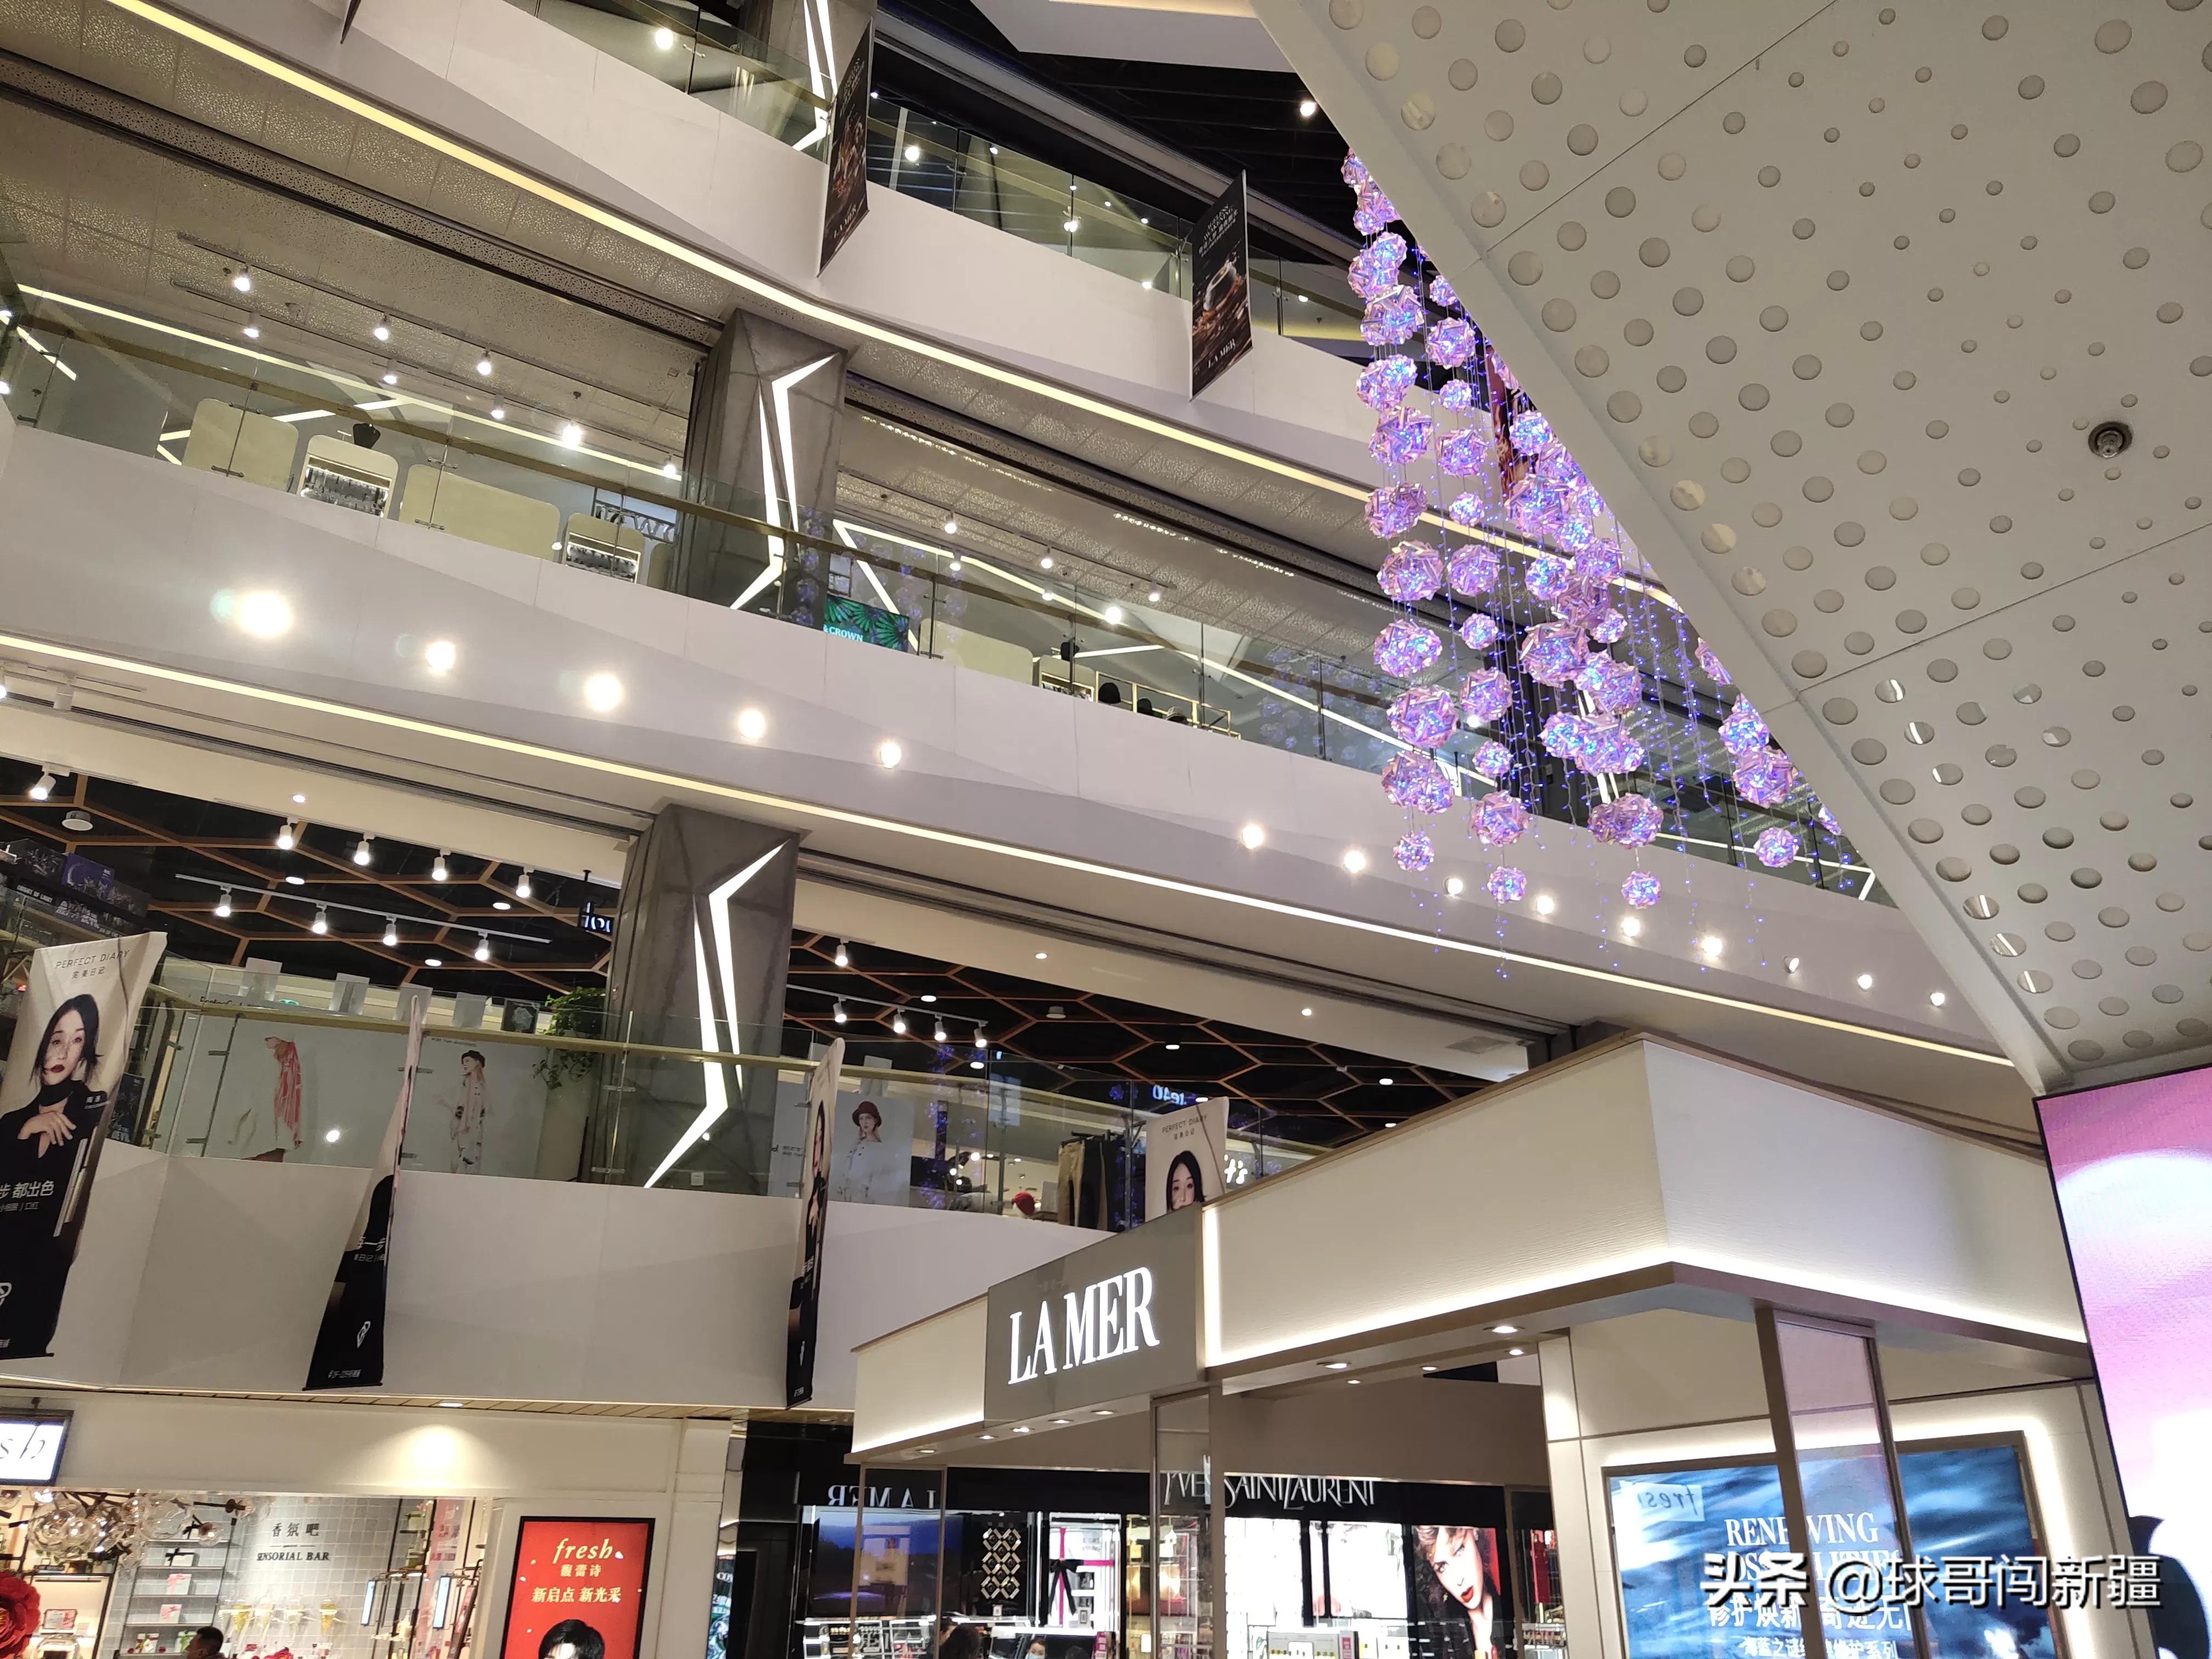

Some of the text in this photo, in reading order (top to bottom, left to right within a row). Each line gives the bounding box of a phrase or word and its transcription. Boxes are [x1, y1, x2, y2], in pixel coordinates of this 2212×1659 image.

[55, 950, 130, 969] PERFECT DIARY
[1162, 1120, 1186, 1133] PERFECT
[12, 1180, 54, 1198] 都出色
[1008, 1267, 1160, 1385] LA MER
[273, 1522, 320, 1537] 香氛吧
[306, 1551, 330, 1561] BAR
[552, 1537, 613, 1565] fresh
[531, 1587, 621, 1602] 新启点 新光采
